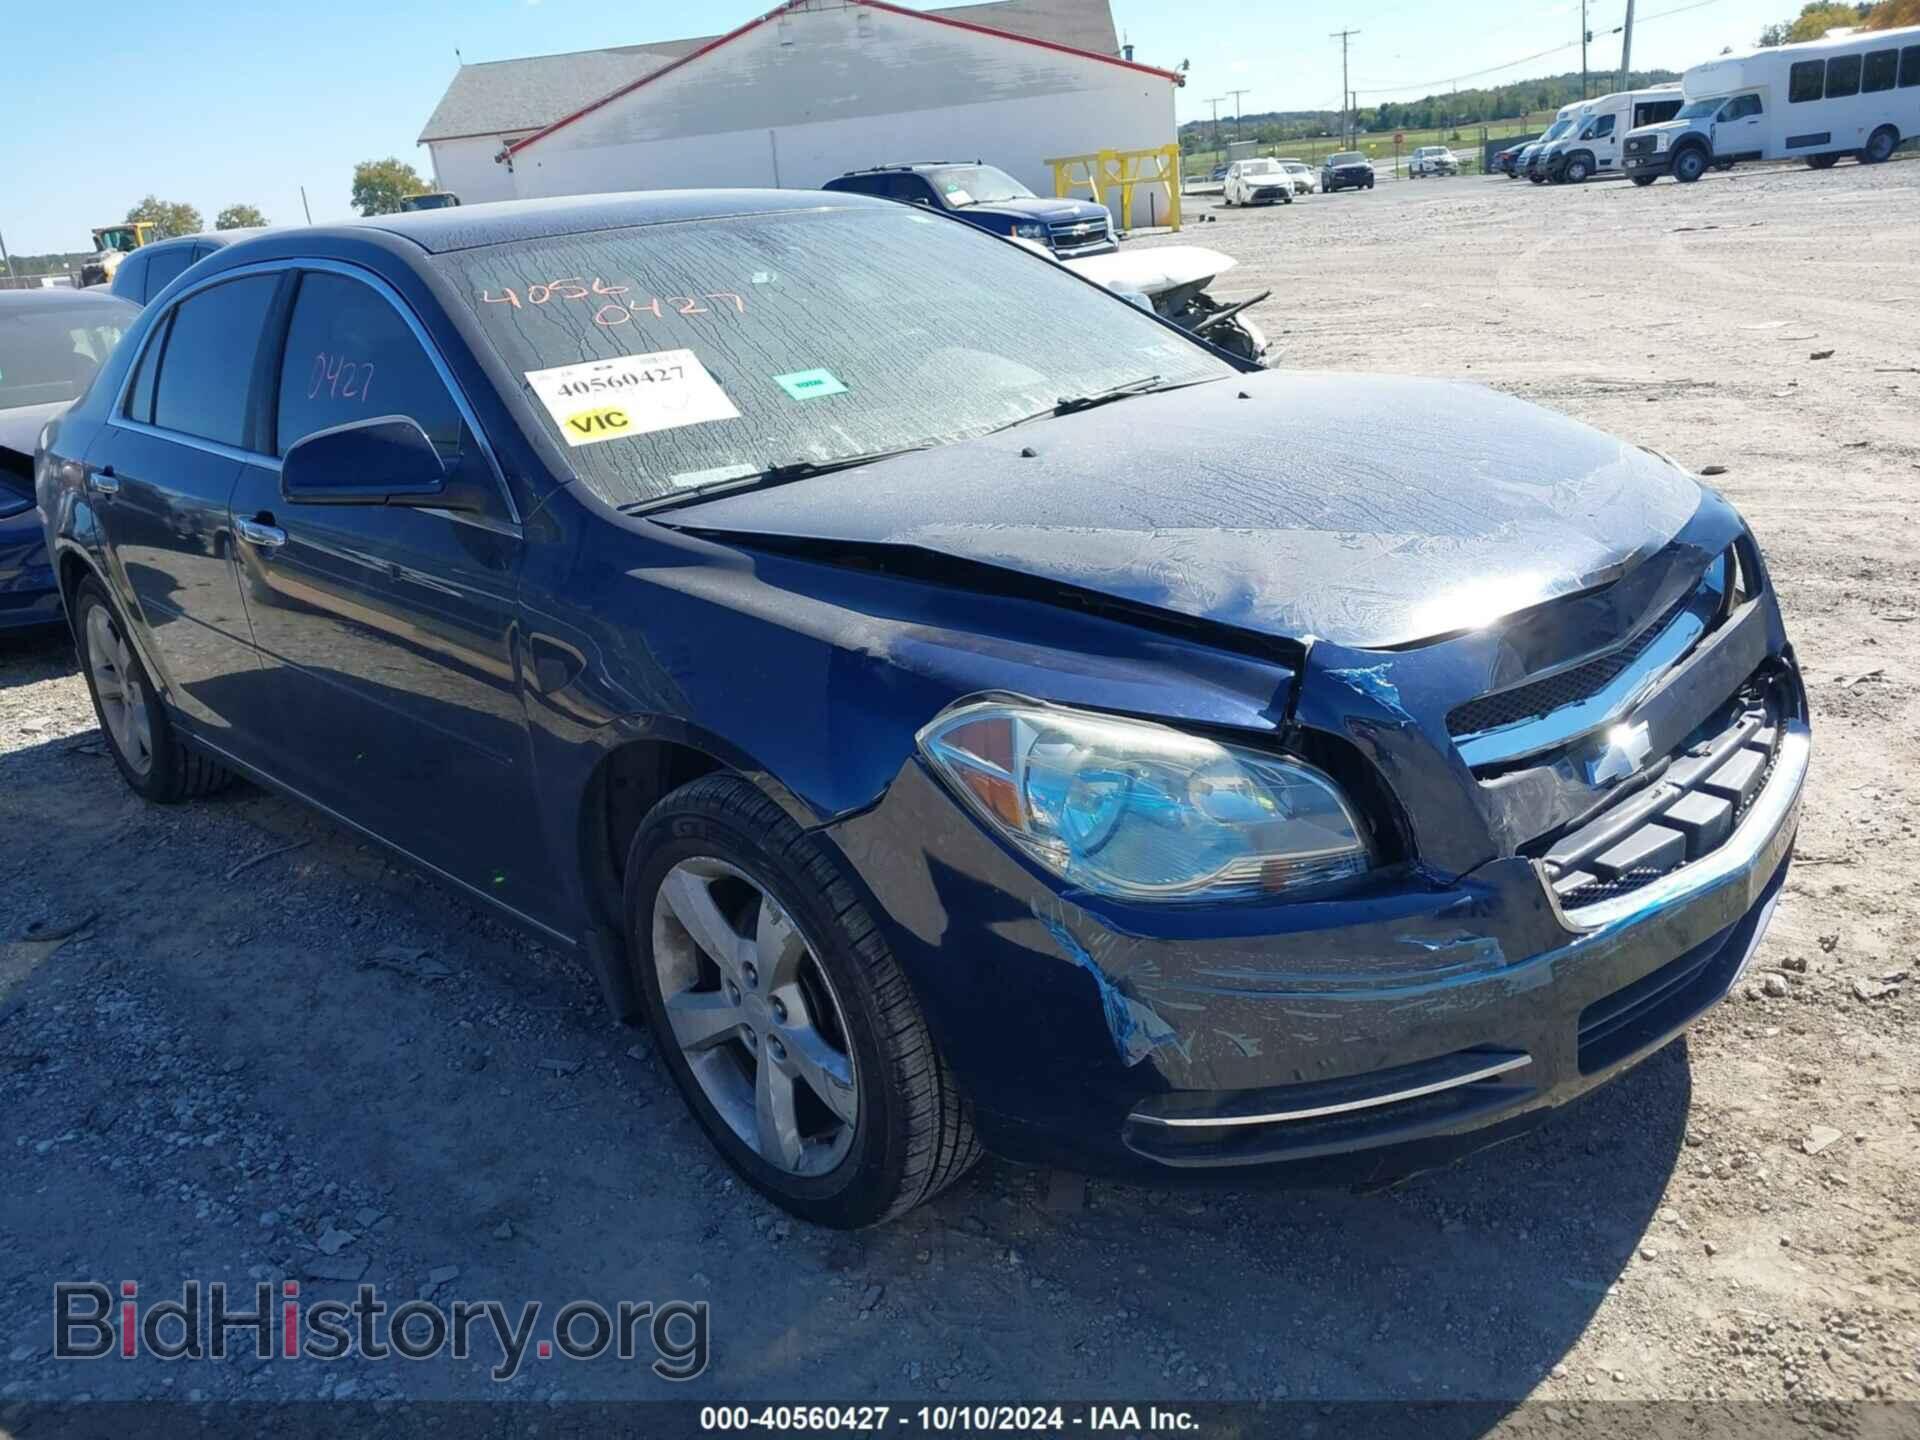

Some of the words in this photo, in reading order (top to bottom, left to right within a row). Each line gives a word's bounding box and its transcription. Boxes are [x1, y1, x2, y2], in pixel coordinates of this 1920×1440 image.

[480, 277, 629, 309] 4056
[595, 292, 744, 326] 0427
[558, 365, 684, 397] 40560427
[570, 411, 629, 433] VIC
